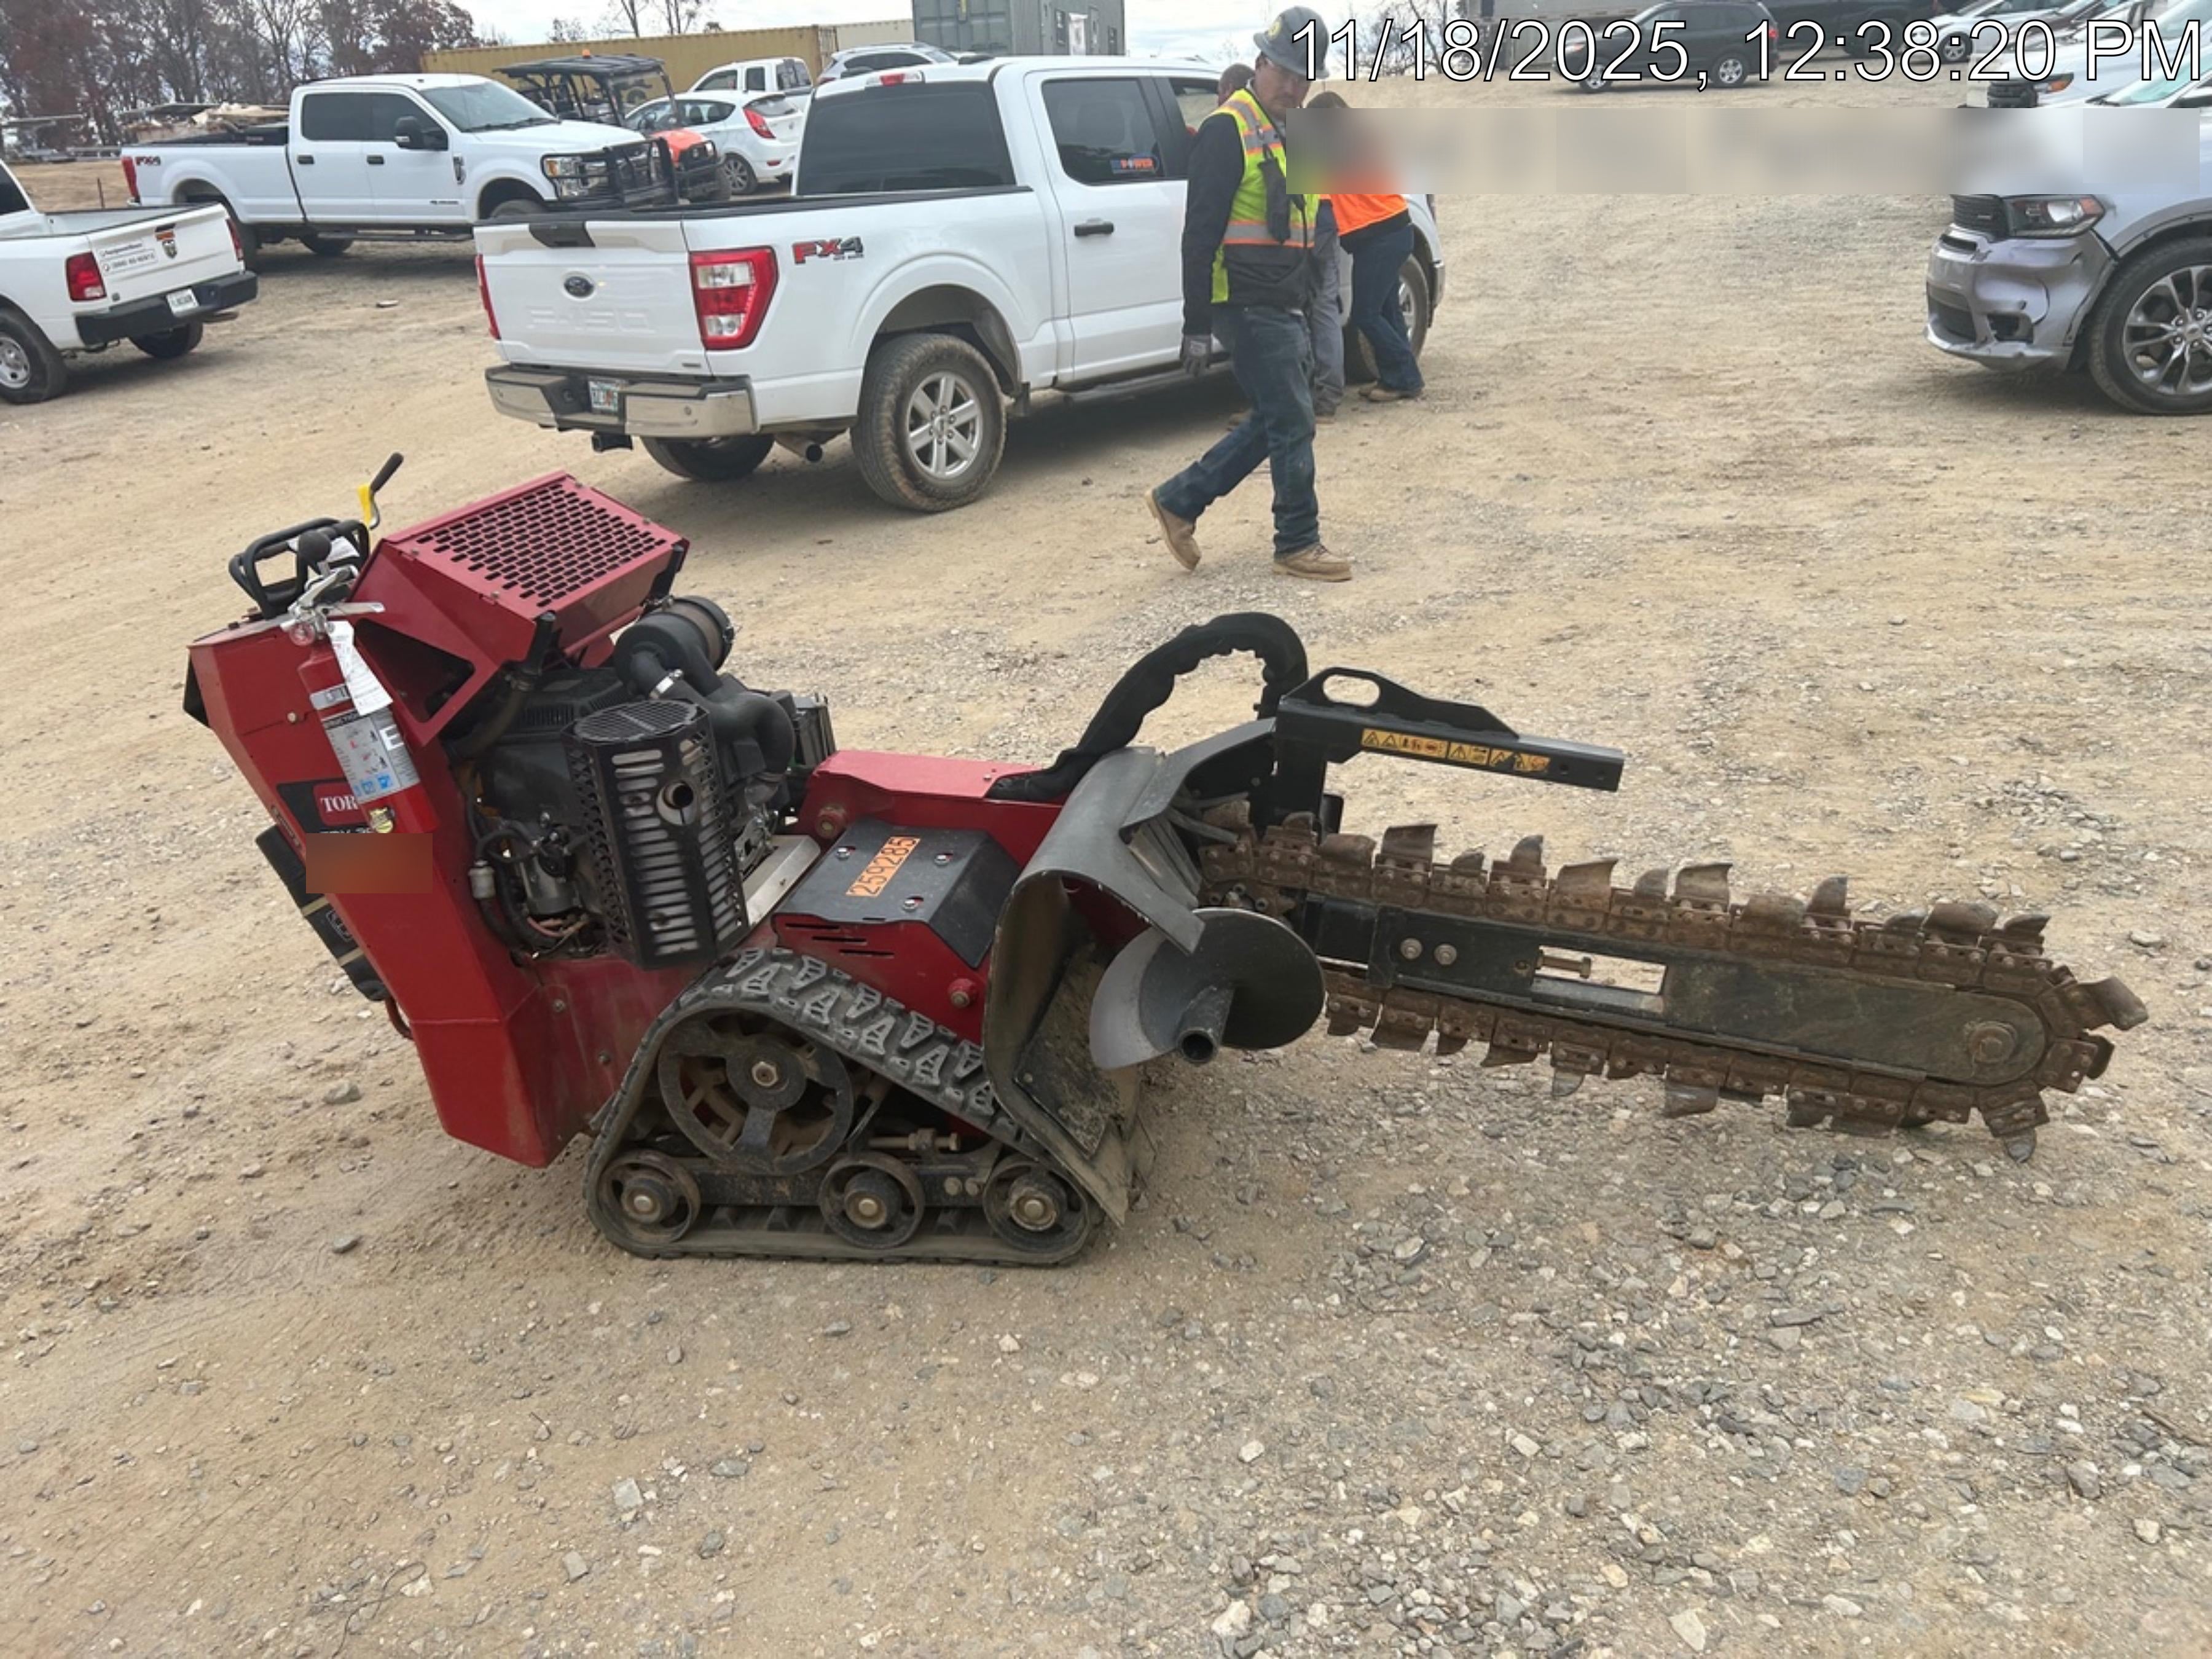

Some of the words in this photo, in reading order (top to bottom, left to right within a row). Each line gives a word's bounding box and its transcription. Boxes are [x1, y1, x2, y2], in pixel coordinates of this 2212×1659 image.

[792, 237, 863, 264] FX4
[320, 795, 359, 812] TOR
[849, 838, 917, 895] 259285
